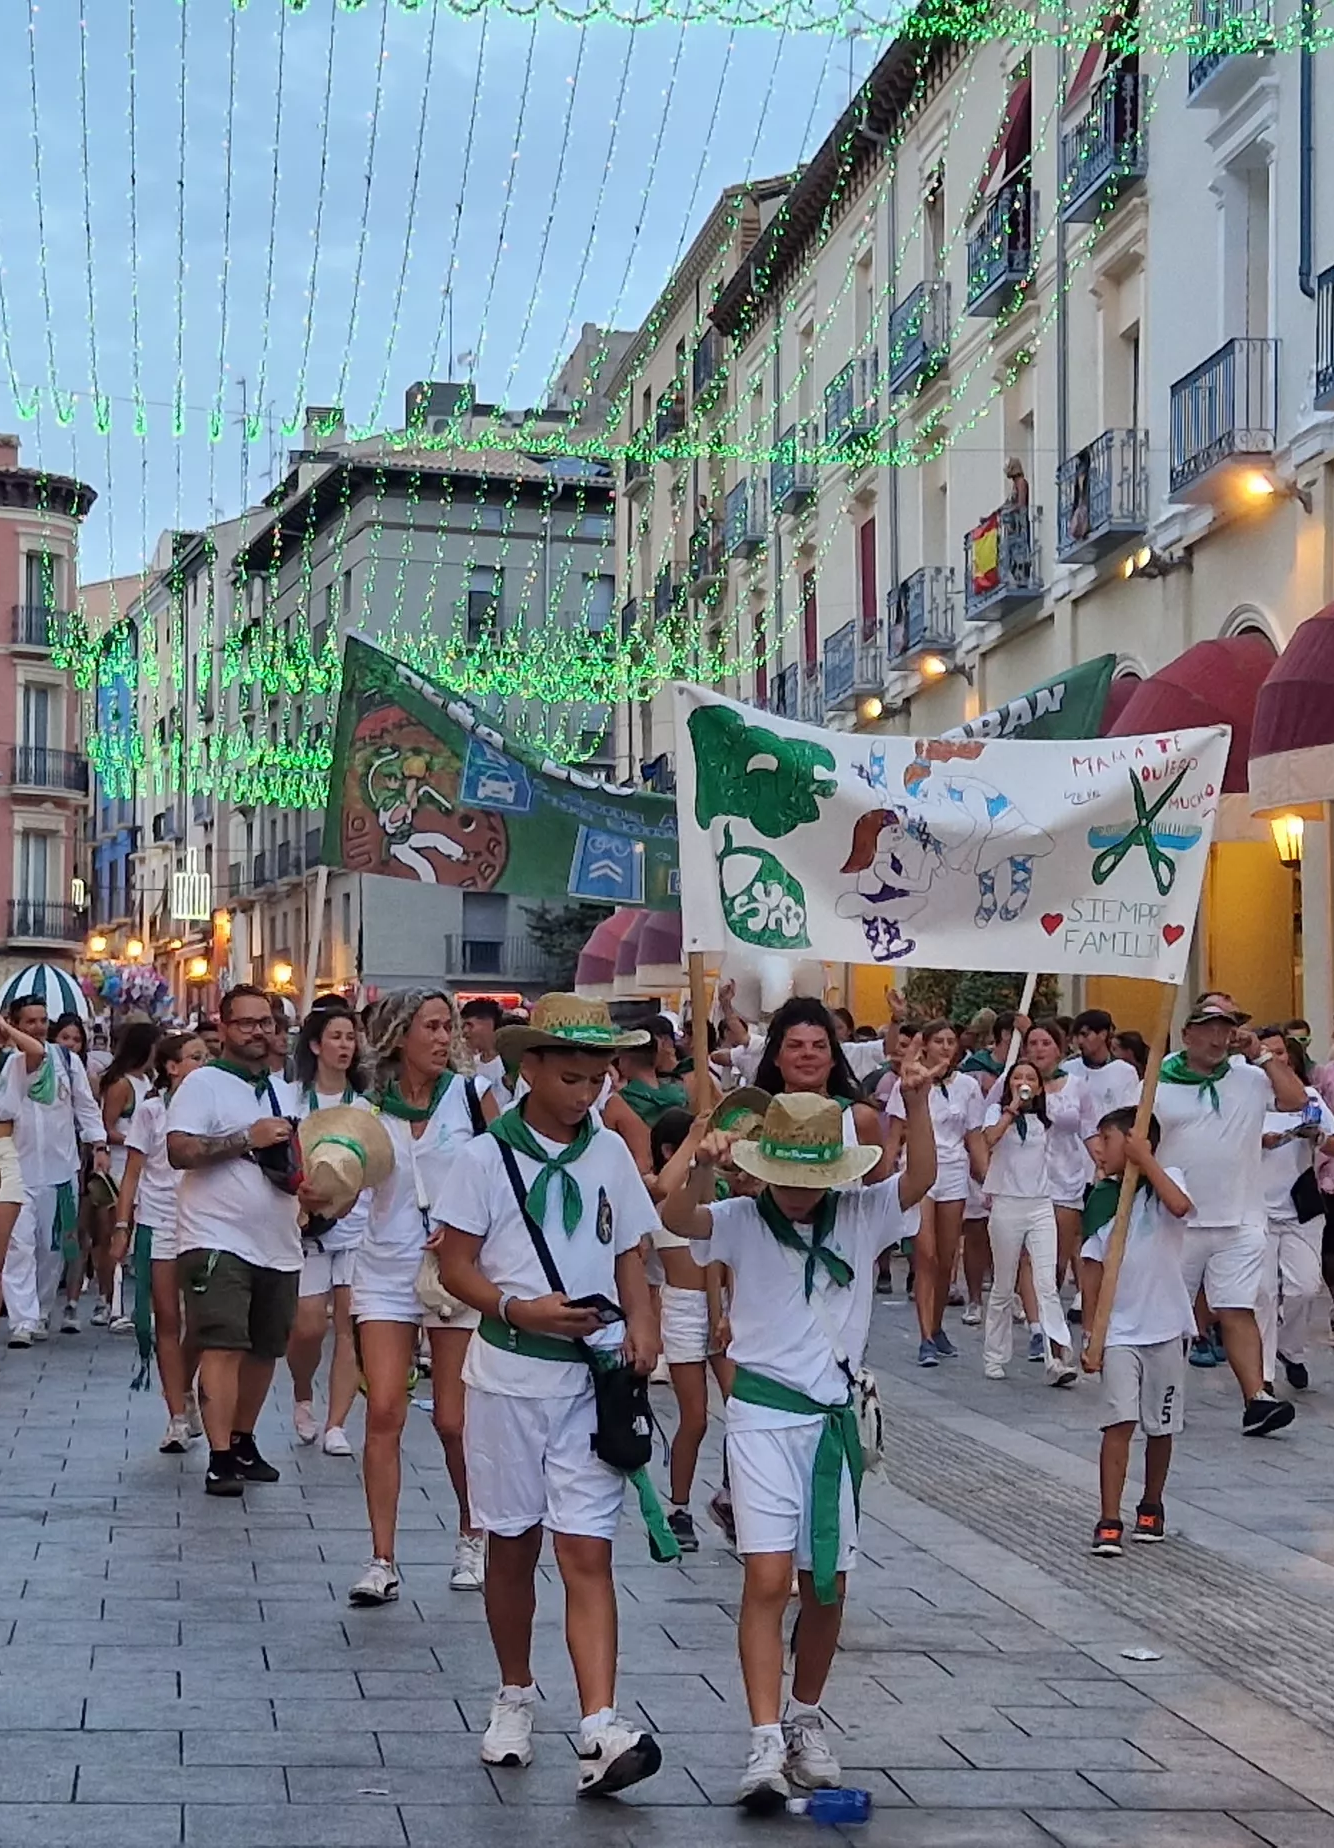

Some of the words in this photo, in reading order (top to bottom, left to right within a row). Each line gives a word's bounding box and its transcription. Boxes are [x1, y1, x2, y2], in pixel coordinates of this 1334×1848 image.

[939, 682, 1066, 739] BAN
[1155, 734, 1181, 753] TE
[1141, 757, 1199, 782] QUIERO
[1168, 783, 1215, 811] MUCHO
[1067, 896, 1168, 928] SIEMPR
